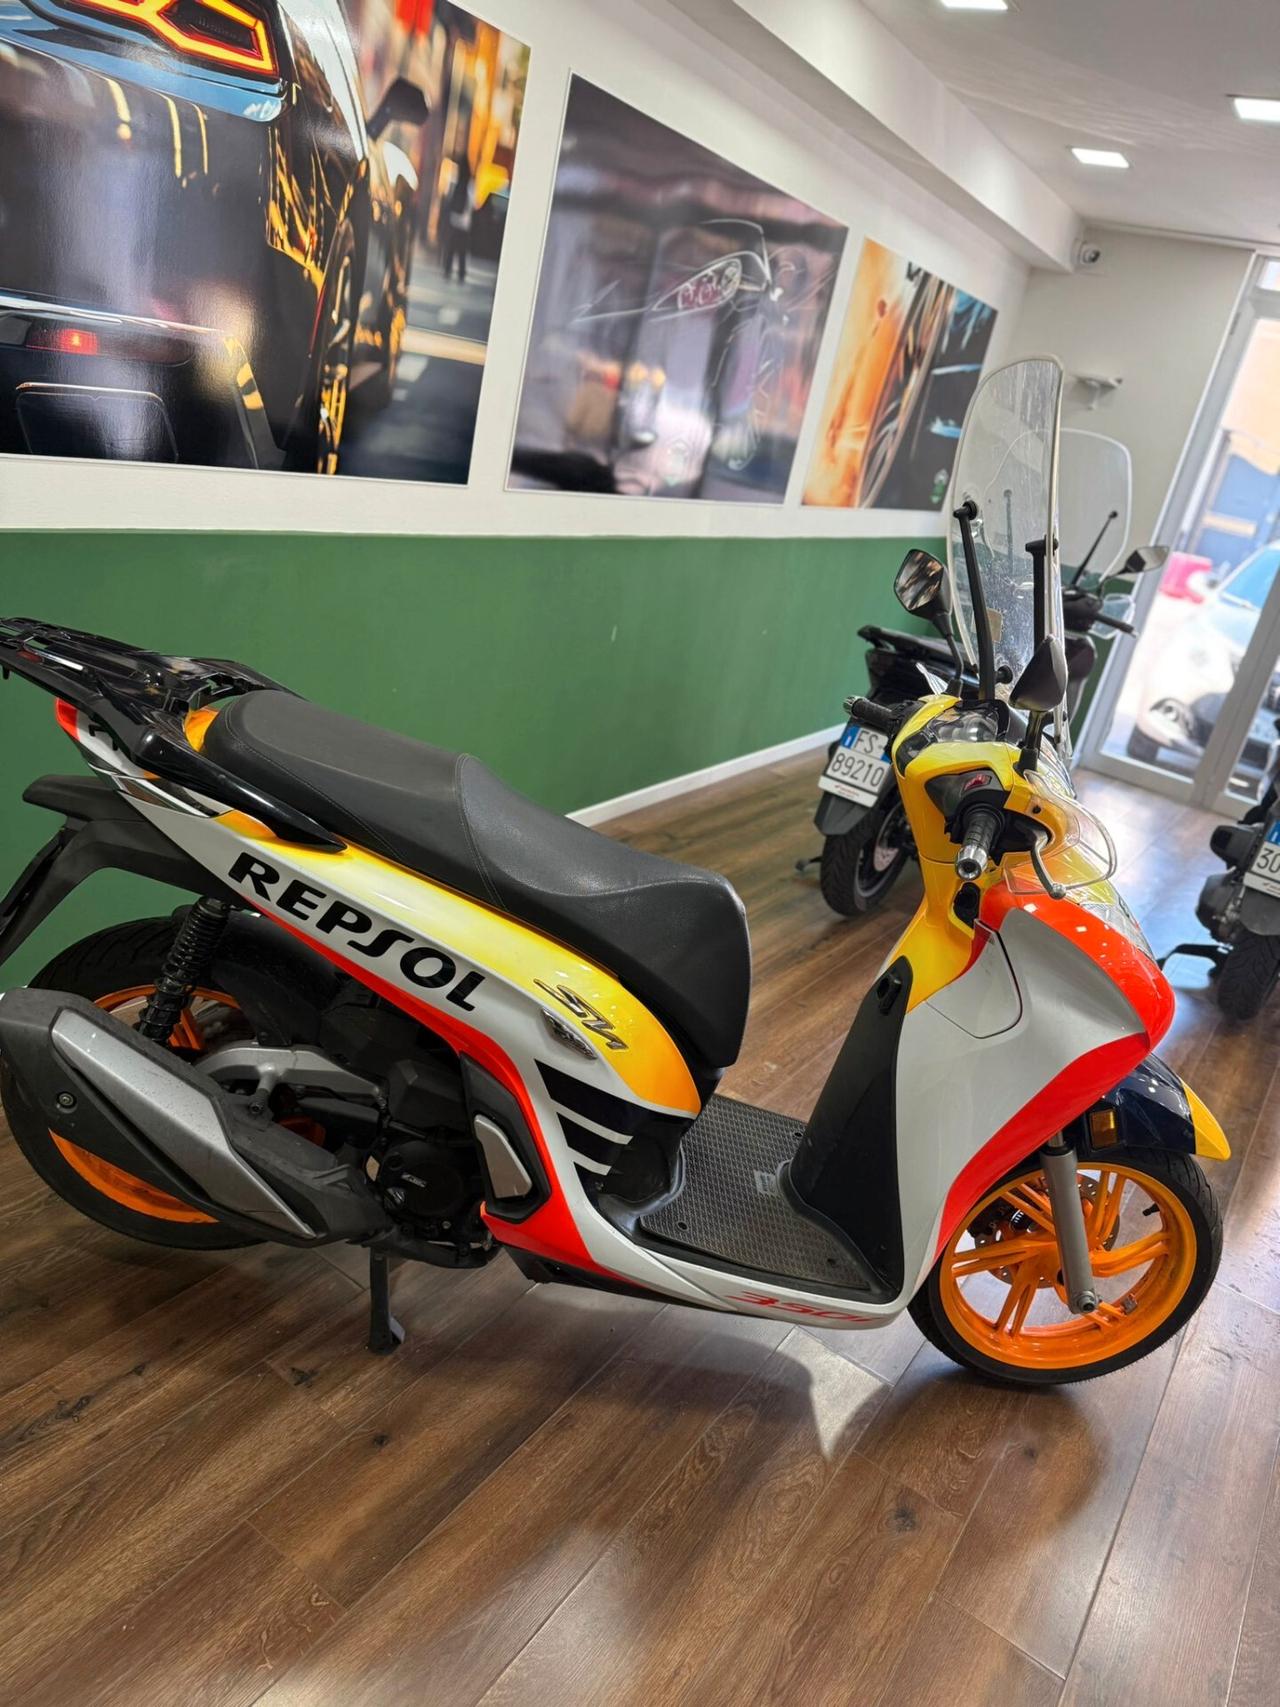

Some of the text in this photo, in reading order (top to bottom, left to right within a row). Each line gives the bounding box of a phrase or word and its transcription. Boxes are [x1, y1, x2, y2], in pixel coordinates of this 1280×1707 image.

[854, 730, 879, 754] FS
[831, 752, 885, 787] 89210
[228, 851, 488, 1012] REPSOL
